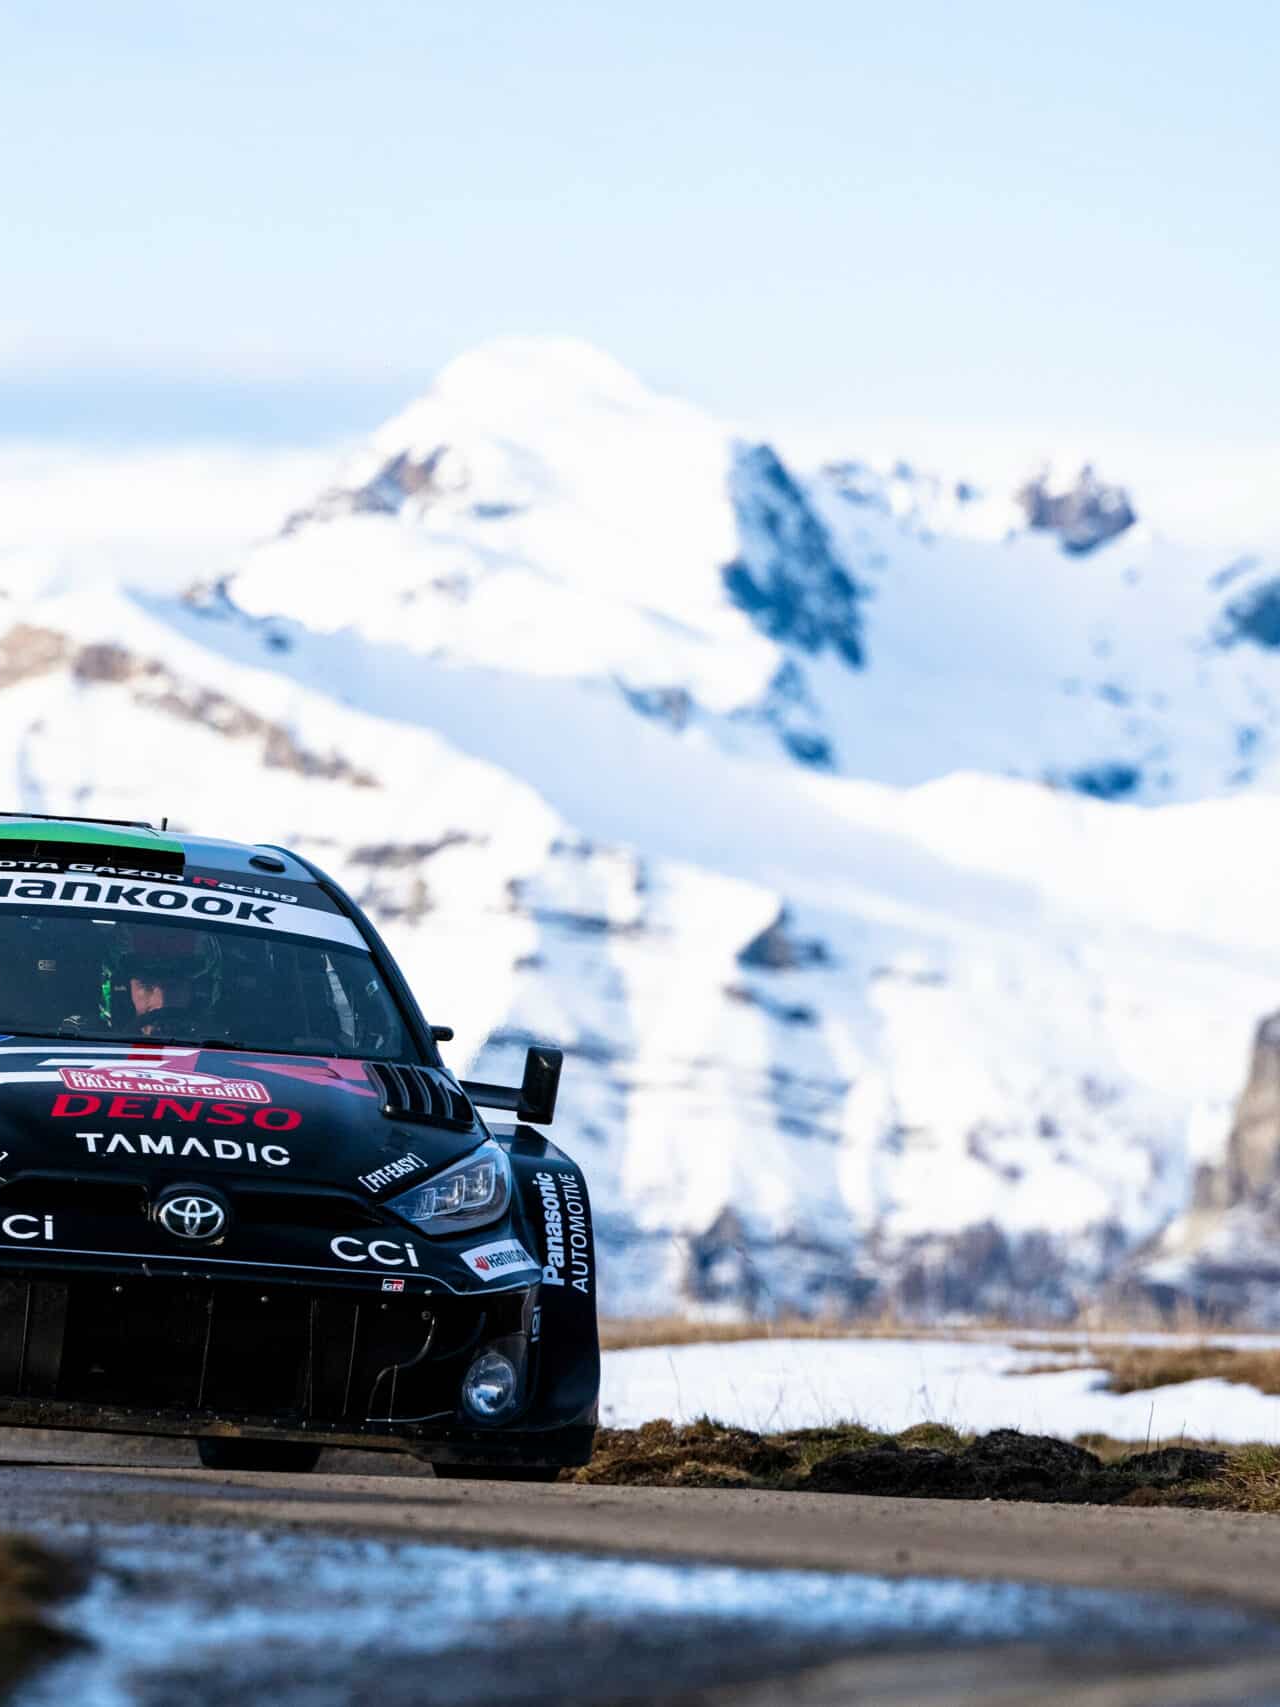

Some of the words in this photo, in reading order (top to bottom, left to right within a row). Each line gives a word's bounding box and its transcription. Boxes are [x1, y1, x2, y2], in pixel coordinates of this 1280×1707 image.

[68, 863, 184, 883] GAZOO
[192, 876, 299, 903] Racing
[72, 1074, 135, 1090] RALLYE
[50, 1093, 303, 1131] DENSO
[75, 1132, 292, 1166] TAMADIC
[532, 1171, 566, 1287] Panasonic
[559, 1173, 589, 1294] AUTOMOTIVE
